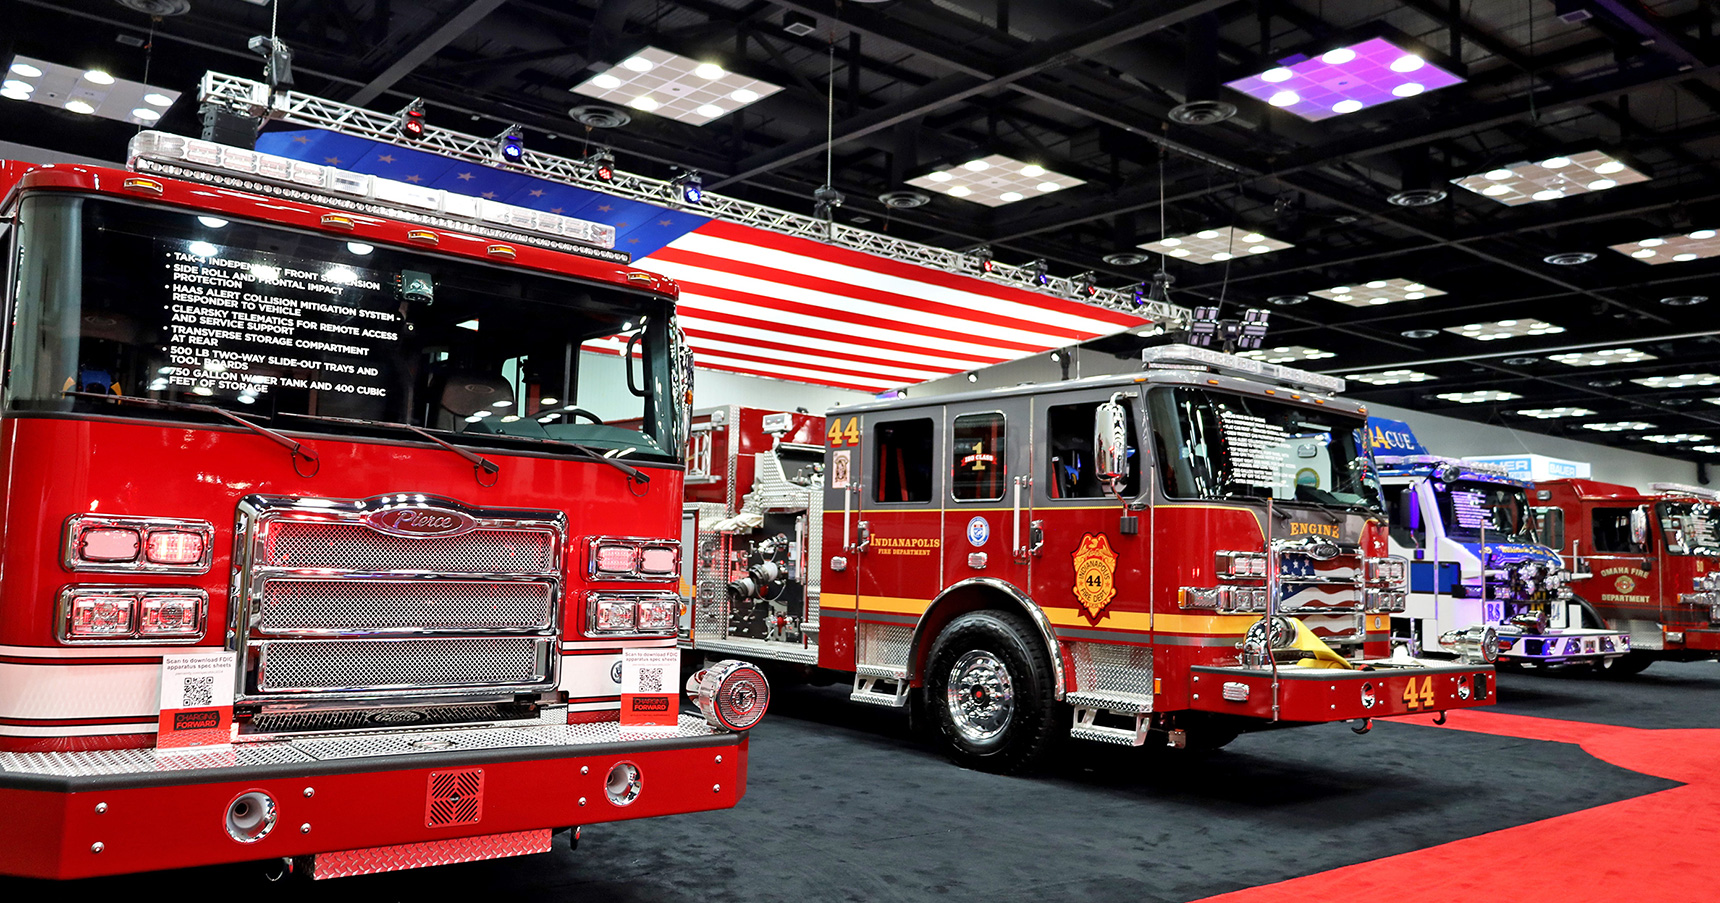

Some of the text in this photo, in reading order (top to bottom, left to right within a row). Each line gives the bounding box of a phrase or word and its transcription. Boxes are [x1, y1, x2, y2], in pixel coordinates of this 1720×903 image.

[174, 252, 380, 290] TAK-4 INDEPENT FRONT SNSION
[174, 264, 198, 274] SIDE
[202, 268, 230, 279] ROLL
[232, 272, 255, 282] AND
[308, 283, 343, 295] IMPACT
[174, 272, 242, 288] PROTECTION
[173, 284, 203, 294] HAAS
[206, 288, 241, 300] ALERT
[244, 293, 297, 307] COLLISION
[300, 301, 356, 316] MITIGATION
[359, 309, 394, 321] SYSTEM
[173, 293, 301, 316] RESPONDER TO VEHICLE
[172, 304, 398, 341] CLEARSKY TELEMATICS FOR REMOTE ACCESS
[172, 314, 294, 335] AND SERVICE SUPPORT
[171, 334, 218, 346] AT REAR
[171, 325, 369, 356] TRANSVERSE STORAGE COMPARTMENT
[170, 346, 378, 376] 500 LB TWO-WAY SLIDE-OUT TRAYS AND
[170, 355, 248, 370] TOOL BOARDS
[169, 376, 268, 393] FEET OF STORAGE
[170, 367, 386, 396] 750 GALLON WER TANK AND 400 CUBIC
[827, 416, 859, 447] 44
[972, 442, 985, 470] 1
[1550, 464, 1575, 476] BAUER
[392, 510, 452, 528] Pierce
[1290, 522, 1340, 539] ENGINE
[1079, 561, 1110, 580] INDIANAPOLIS
[1601, 567, 1649, 579] OMAHA FIRE
[1086, 575, 1101, 587] 44
[1081, 588, 1091, 601] FIRE
[1602, 594, 1650, 602] DEPARTMENT
[1403, 676, 1434, 709] 44
[176, 712, 217, 720] CHARGING
[176, 720, 216, 728] FORWARD
